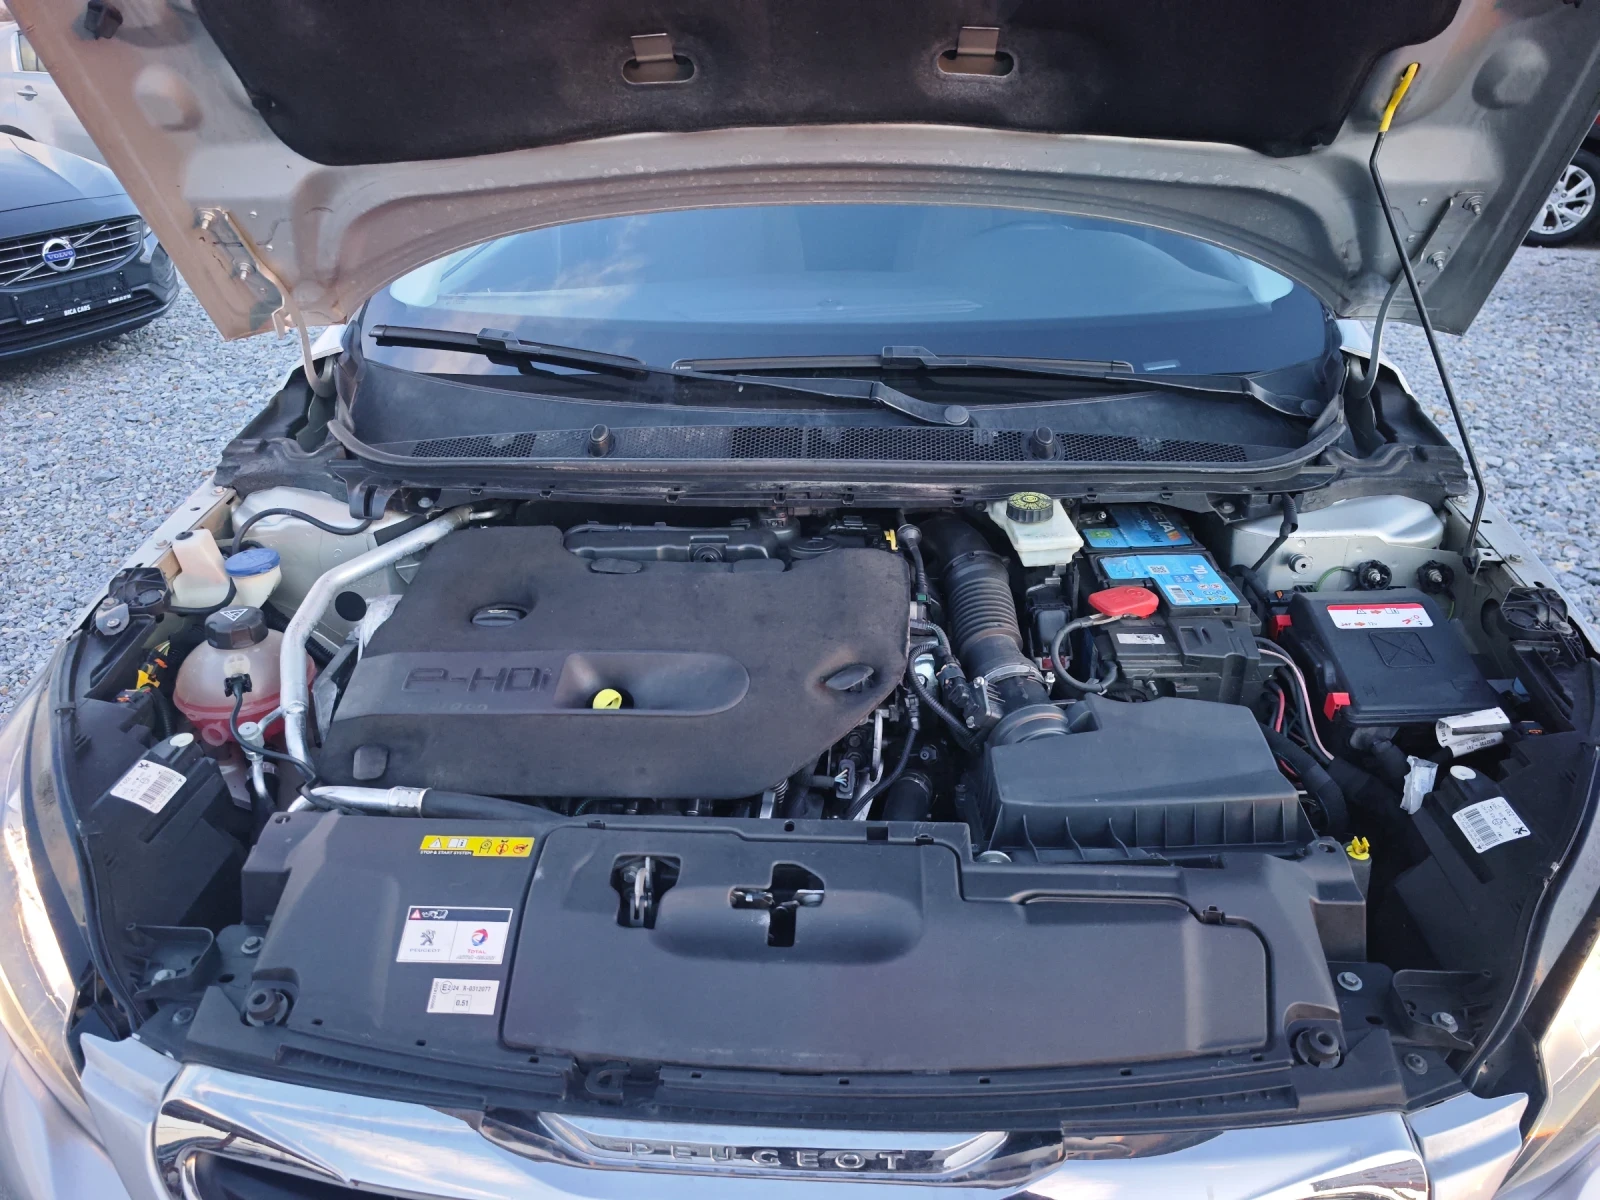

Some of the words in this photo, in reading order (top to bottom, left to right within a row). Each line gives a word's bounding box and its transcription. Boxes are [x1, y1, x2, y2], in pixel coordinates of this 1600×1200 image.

[47, 250, 74, 260] VOLVO
[455, 999, 469, 1007] 0.51
[629, 1141, 906, 1170] PEUGEOT
